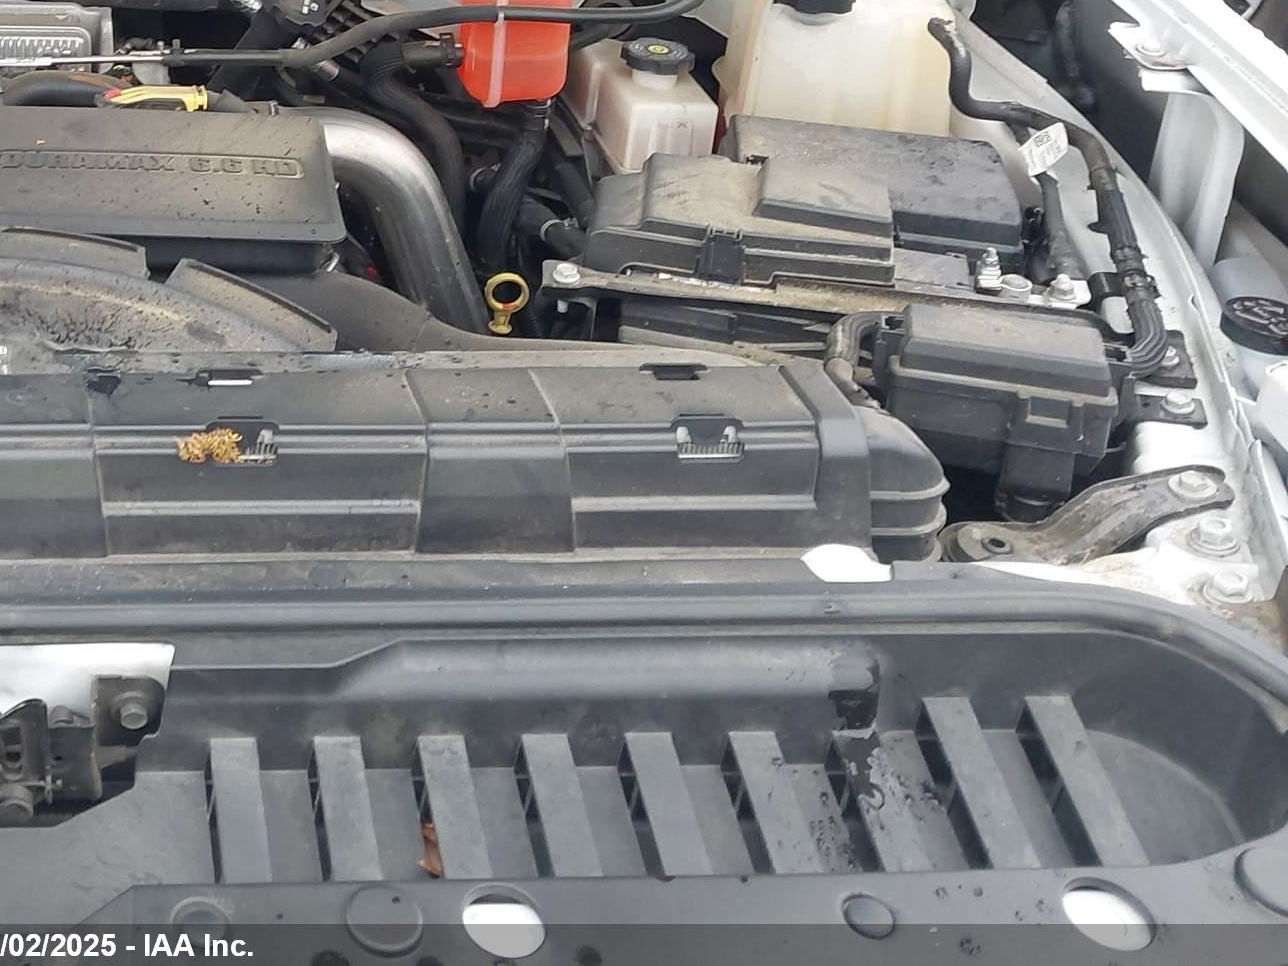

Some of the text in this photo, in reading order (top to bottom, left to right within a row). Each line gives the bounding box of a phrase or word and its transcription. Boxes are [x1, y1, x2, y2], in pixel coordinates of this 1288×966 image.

[0, 152, 299, 177] DURAMAX 6.6 HD
